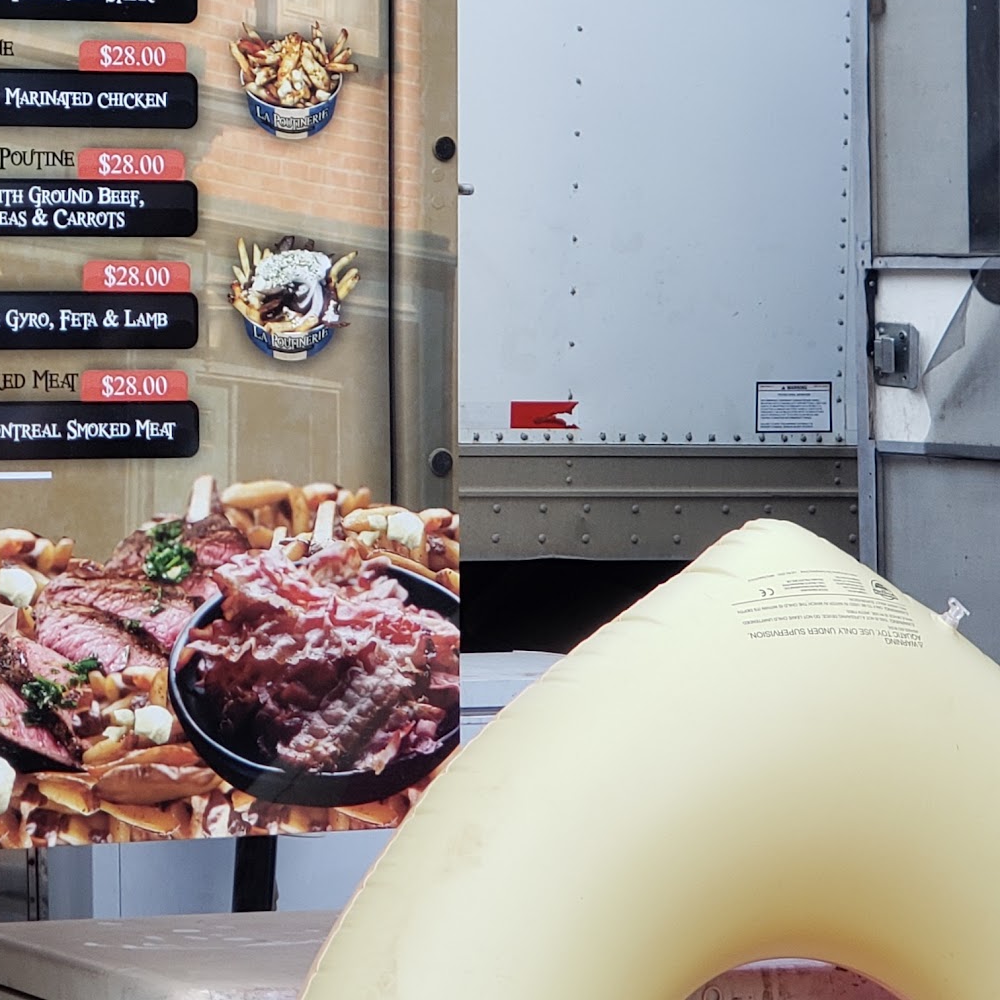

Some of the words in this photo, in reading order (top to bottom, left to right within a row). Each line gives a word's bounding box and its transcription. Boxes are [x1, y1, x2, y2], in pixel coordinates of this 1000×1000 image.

[100, 44, 165, 67] $28.00
[5, 87, 93, 109] MARINATED
[98, 91, 167, 109] CHICKEN
[99, 154, 164, 176] $28.00
[28, 186, 93, 207] GROUND
[97, 188, 144, 208] BEEF,
[32, 210, 47, 227] &
[53, 209, 125, 230] CARROTS
[104, 265, 170, 287] $28.00
[5, 310, 54, 331] GYRO,
[59, 310, 98, 330] FETA
[102, 310, 119, 328] &
[123, 310, 168, 330] LAMB
[33, 370, 79, 392] MEAT
[101, 375, 167, 398] $28.00
[66, 420, 130, 440] SMOKED
[135, 419, 176, 440] MEAT
[748, 628, 806, 639] SUPERVISION.
[807, 627, 836, 635] UNDER
[892, 631, 921, 641] AQUATIC
